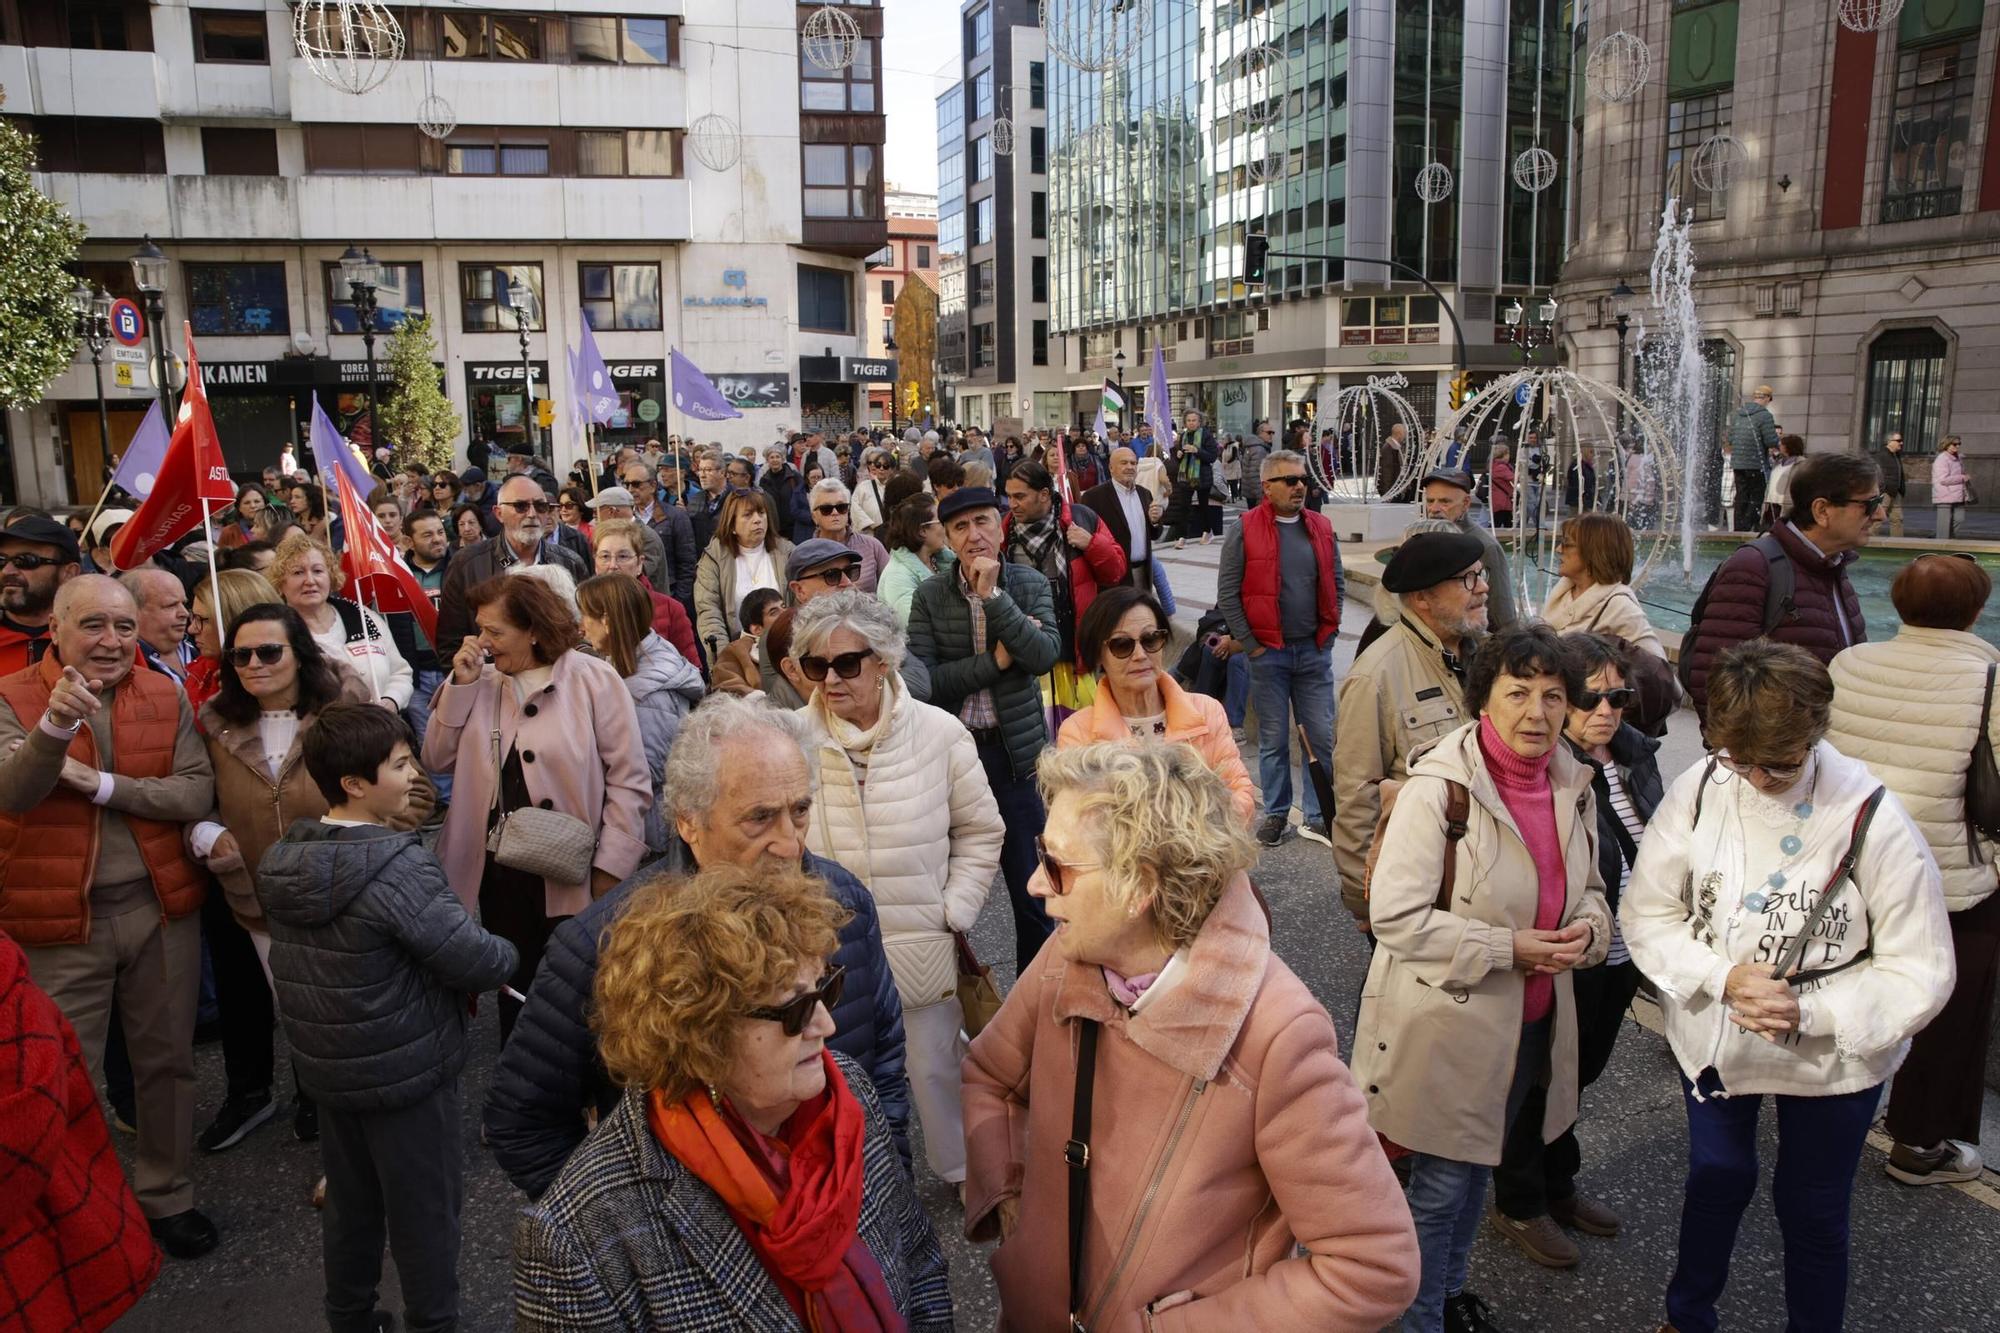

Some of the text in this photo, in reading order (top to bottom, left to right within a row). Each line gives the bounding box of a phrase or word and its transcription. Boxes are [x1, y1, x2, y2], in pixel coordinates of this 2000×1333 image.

[124, 317, 132, 331] P
[116, 349, 143, 359] EMTUSA
[201, 365, 267, 384] KAMEN
[473, 366, 541, 379] TIGER
[607, 365, 658, 378] IGER
[852, 363, 888, 376] TIGER
[374, 373, 394, 382] IBRE
[1766, 912, 1788, 931] IN
